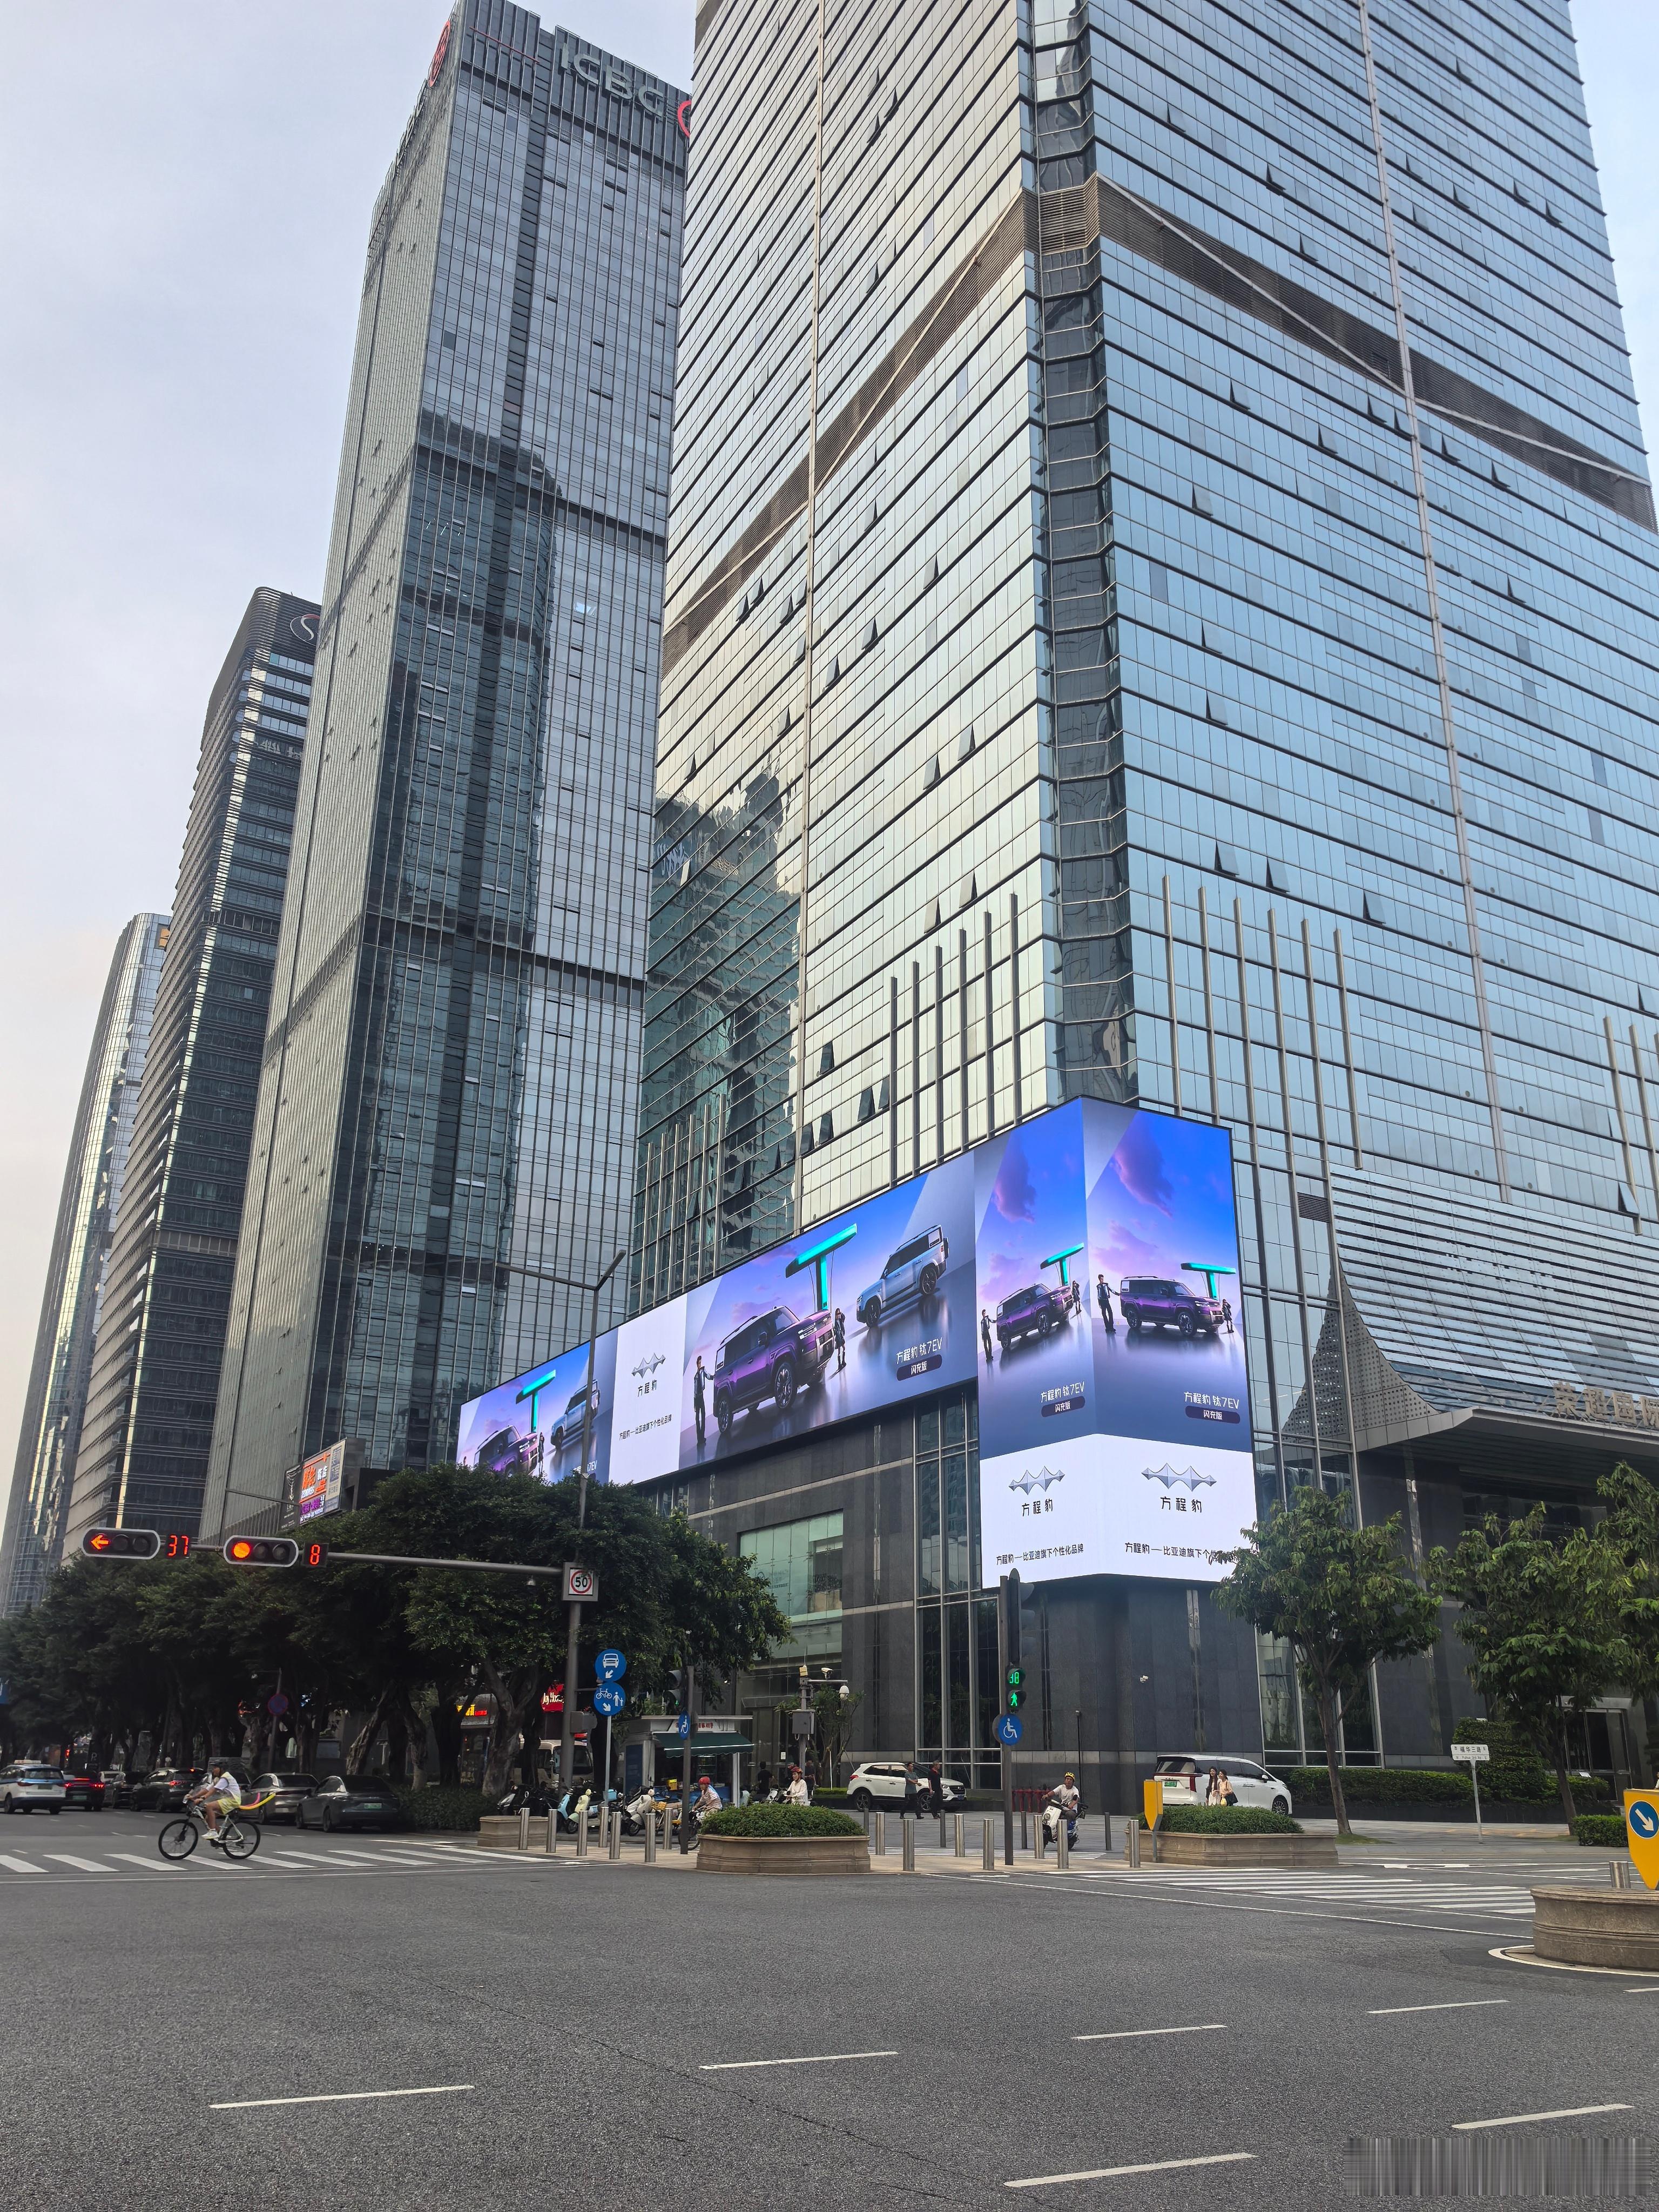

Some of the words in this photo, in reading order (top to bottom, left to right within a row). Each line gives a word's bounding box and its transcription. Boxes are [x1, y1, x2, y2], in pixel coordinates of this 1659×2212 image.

[560, 42, 664, 118] ICBC
[896, 1346, 918, 1365] 方程豹
[919, 1337, 942, 1357] 钛7EV
[911, 1360, 927, 1375] 闪充版
[638, 1379, 657, 1398] 方程豹
[1040, 1387, 1061, 1403] 方程豹
[1062, 1381, 1084, 1397] 钛7EV
[1055, 1400, 1071, 1413] 闪充版
[1183, 1391, 1211, 1405] 方程豹
[1212, 1395, 1239, 1409] 钛7EV
[1203, 1410, 1223, 1420] 闪充版
[1022, 1498, 1053, 1516] 方程豹
[1160, 1496, 1202, 1513] 方程豹
[167, 1535, 189, 1556] 37
[309, 1544, 320, 1565] 8
[575, 1577, 588, 1588] 50
